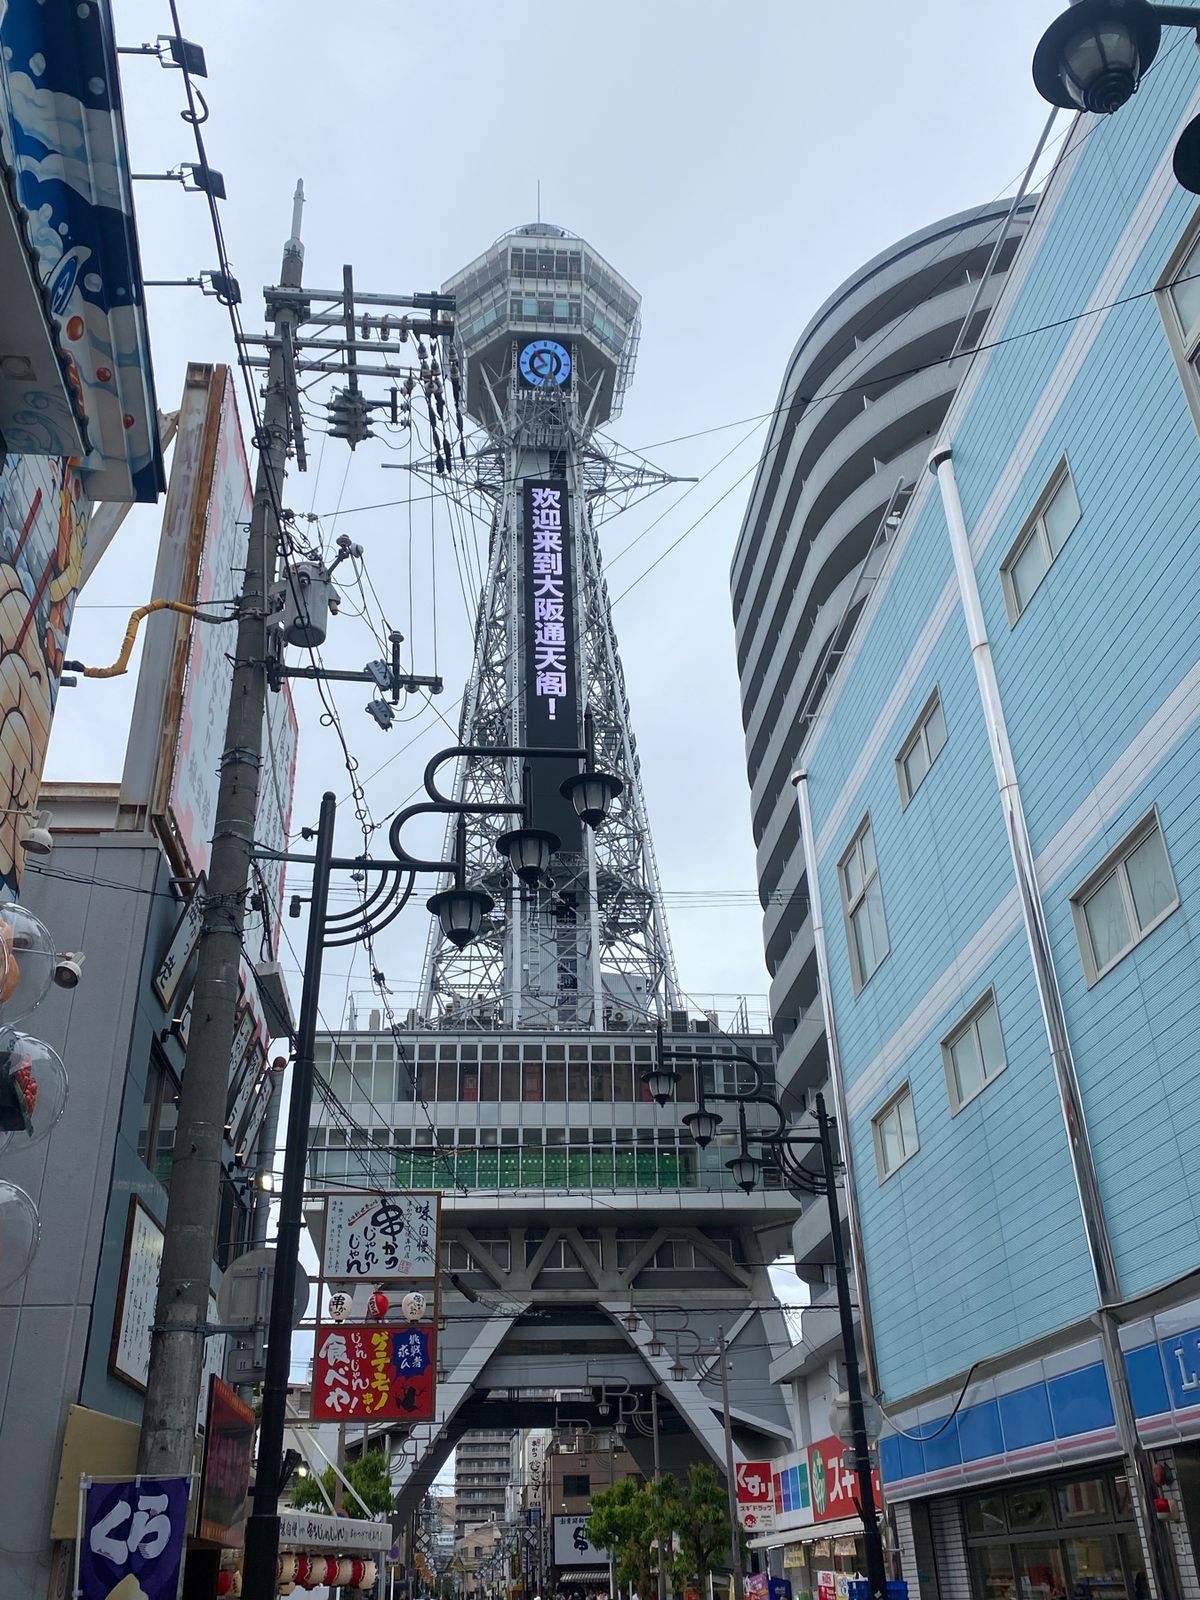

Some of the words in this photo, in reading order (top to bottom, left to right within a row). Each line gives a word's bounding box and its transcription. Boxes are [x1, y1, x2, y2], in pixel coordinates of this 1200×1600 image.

[531, 488, 567, 720] 欢迎来到大阪通天阁!
[371, 1198, 404, 1270] 串かつ
[409, 1334, 423, 1368] 挑戦者
[737, 1465, 771, 1501] くすり
[90, 1494, 171, 1565] くら
